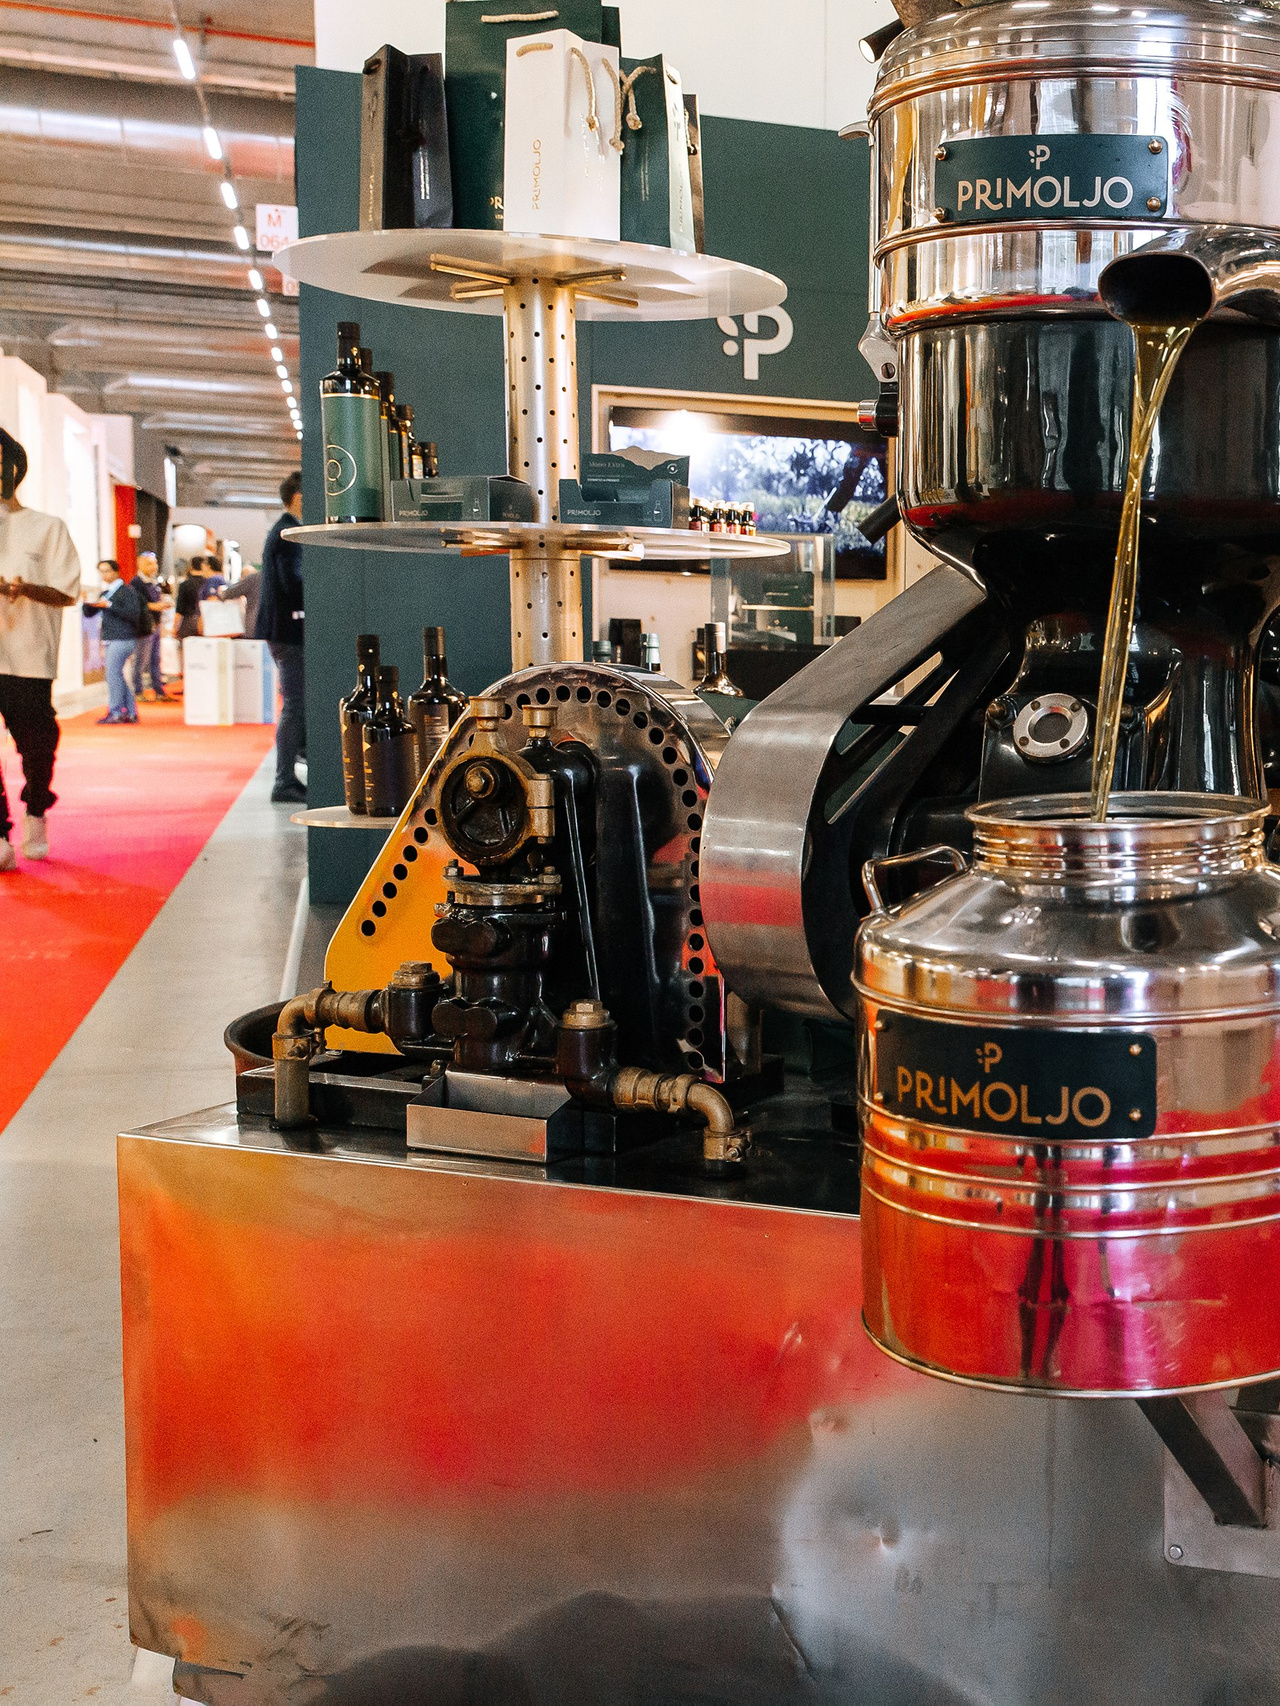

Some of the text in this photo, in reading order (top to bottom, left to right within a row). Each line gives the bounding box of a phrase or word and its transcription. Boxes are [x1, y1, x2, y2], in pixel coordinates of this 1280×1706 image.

[531, 139, 542, 210] PRIMOLJO
[957, 175, 1134, 211] PRIMOLJO
[567, 509, 602, 517] PRIMOLJO
[897, 1066, 1112, 1127] PRIMOLJO
